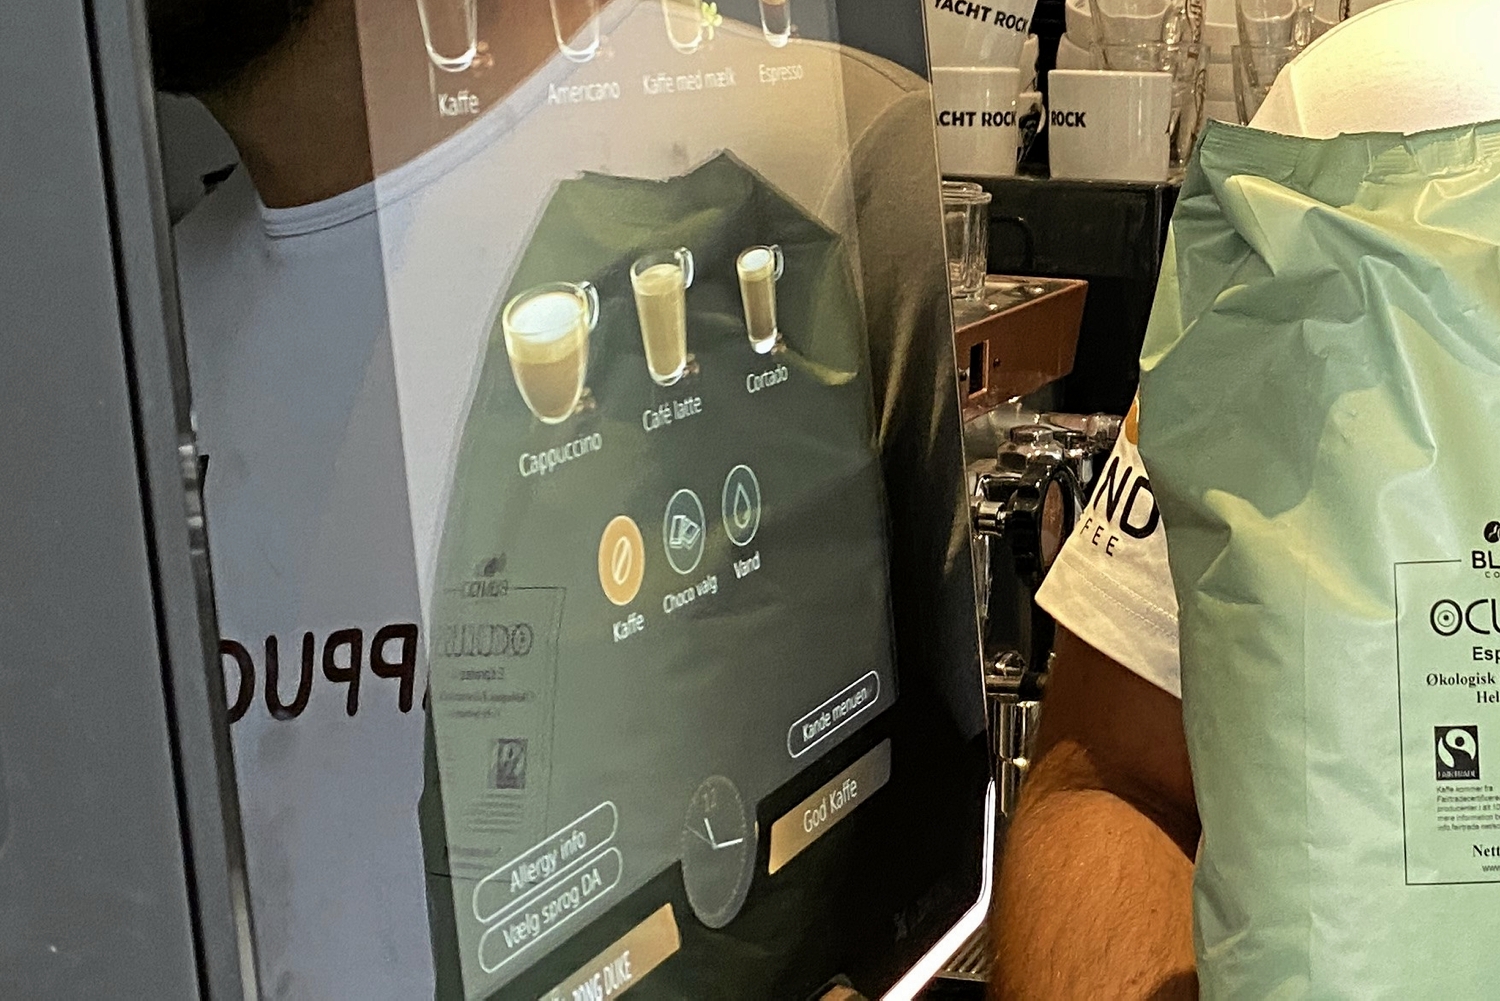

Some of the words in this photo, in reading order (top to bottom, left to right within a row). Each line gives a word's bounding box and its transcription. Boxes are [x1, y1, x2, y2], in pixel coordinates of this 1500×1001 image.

[994, 11, 1029, 32] ROCK
[643, 72, 675, 95] Kaffe
[759, 64, 803, 86] Espresso
[438, 89, 480, 117] Kaffe
[548, 82, 621, 105] Americano
[936, 111, 976, 126] CHT
[1052, 111, 1086, 127] ROCK
[746, 364, 788, 394] Cortado
[642, 405, 673, 432] Café
[674, 395, 702, 422] latte
[519, 432, 602, 478] Cappuccino
[733, 551, 760, 579] Vand
[663, 585, 696, 613] Choco
[696, 574, 718, 596] valg
[612, 612, 645, 642] Kaffe
[1426, 671, 1497, 688] Økologisk
[802, 709, 831, 743] Kande
[832, 687, 869, 723] menuen
[803, 804, 827, 833] God
[830, 777, 858, 814] Kaffe
[510, 851, 557, 893] Allergy
[560, 829, 587, 861] info
[502, 912, 541, 948] Vælg
[541, 886, 580, 924] sprog
[582, 868, 602, 898] DA
[603, 950, 633, 995] DUKE
